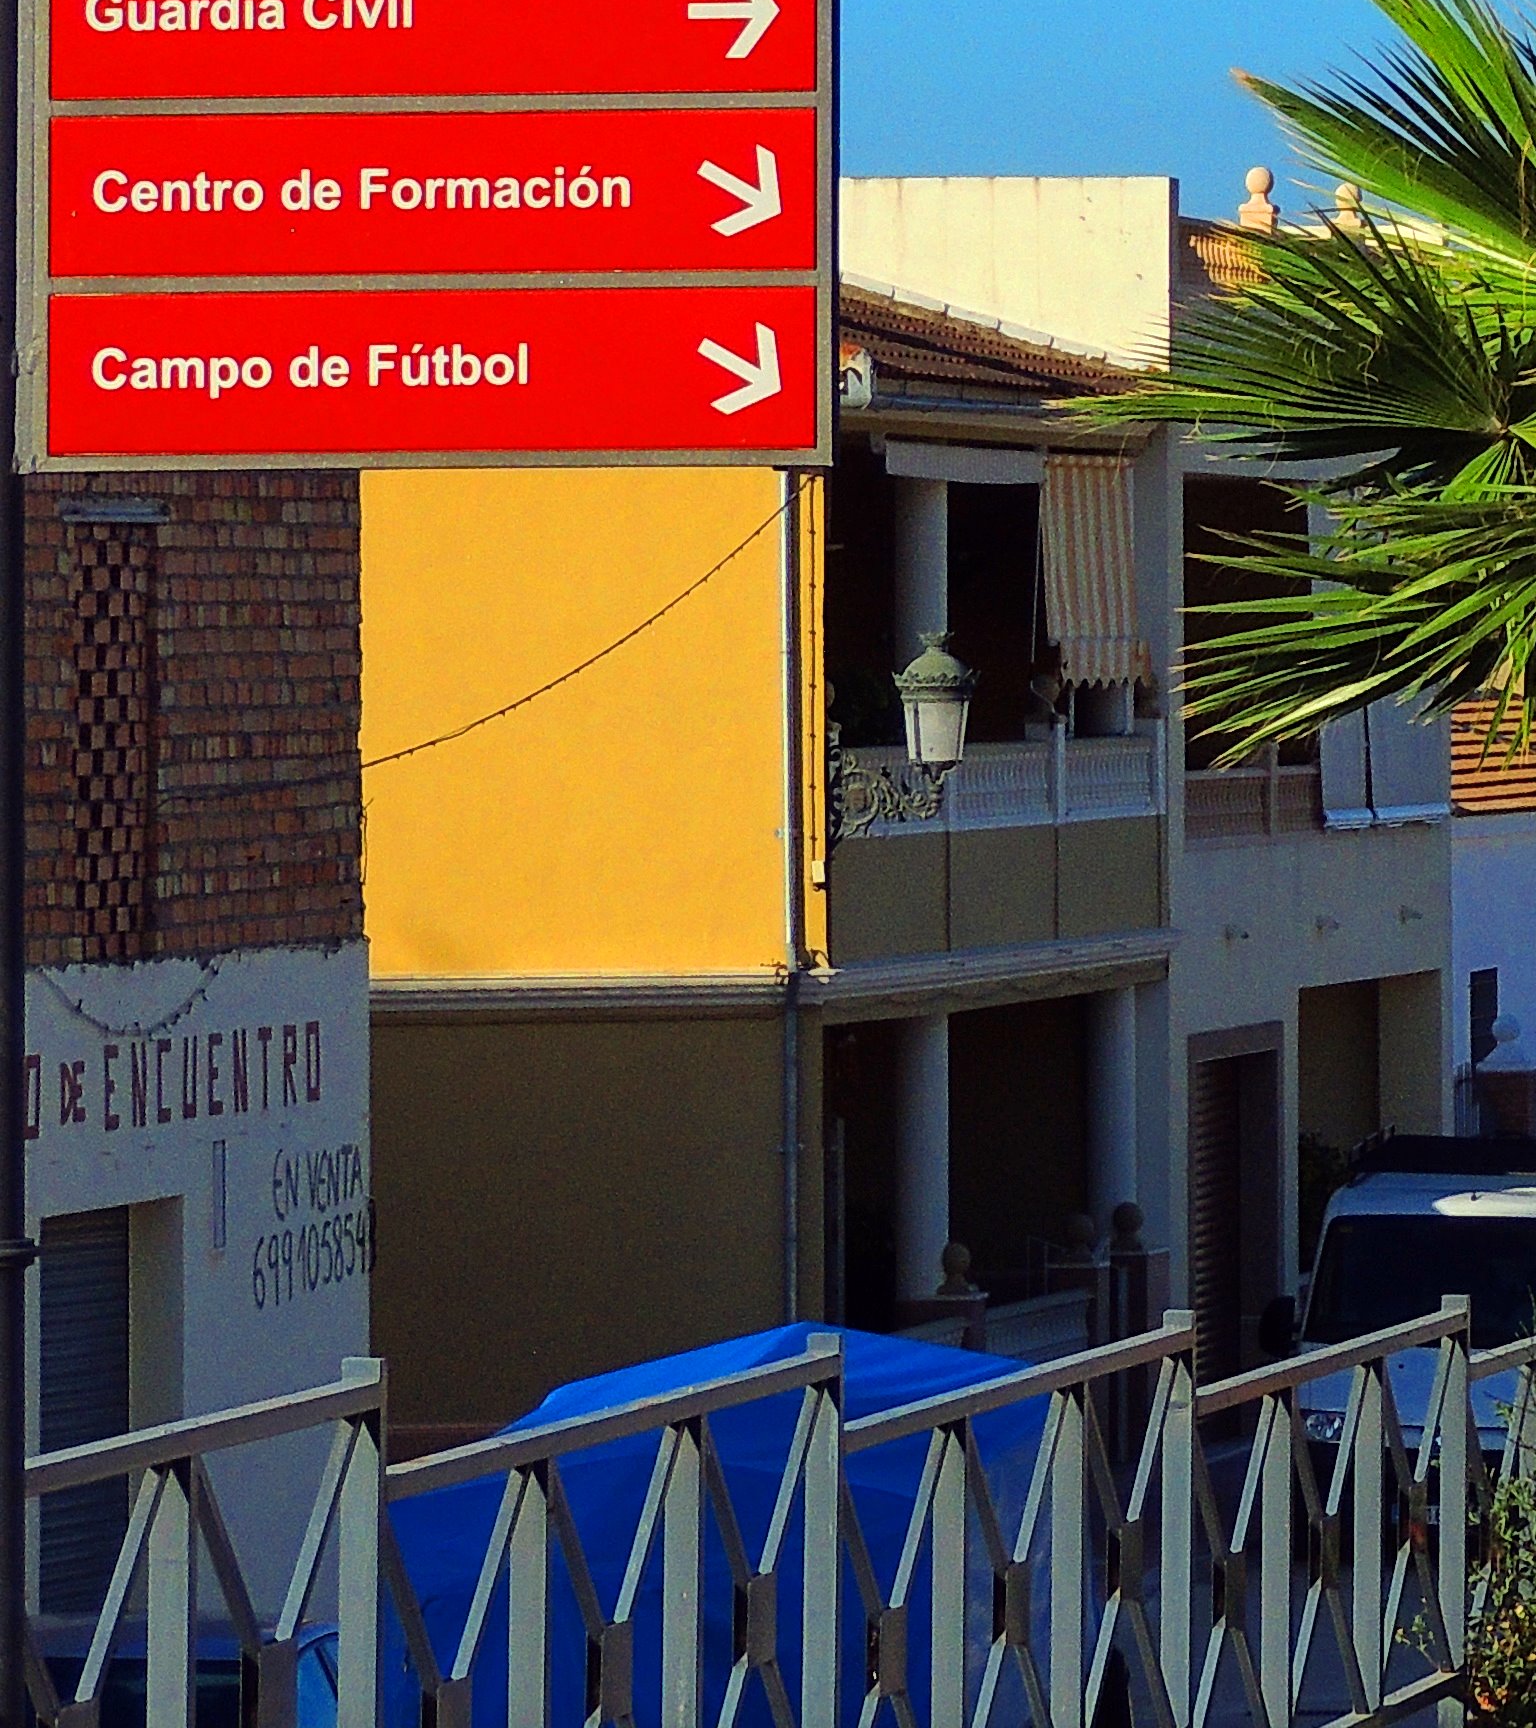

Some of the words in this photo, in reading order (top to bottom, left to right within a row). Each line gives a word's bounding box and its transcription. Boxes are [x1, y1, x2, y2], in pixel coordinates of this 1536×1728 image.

[92, 169, 264, 213] Centro
[281, 168, 342, 211] de
[360, 165, 631, 210] Formación
[92, 347, 273, 400] Campo
[289, 345, 350, 388] de
[368, 342, 528, 387] Fútbol
[59, 1060, 87, 1126] DE
[103, 1020, 321, 1132] ENCUENTRO
[272, 1148, 300, 1222] EN
[306, 1144, 364, 1214] VENTA
